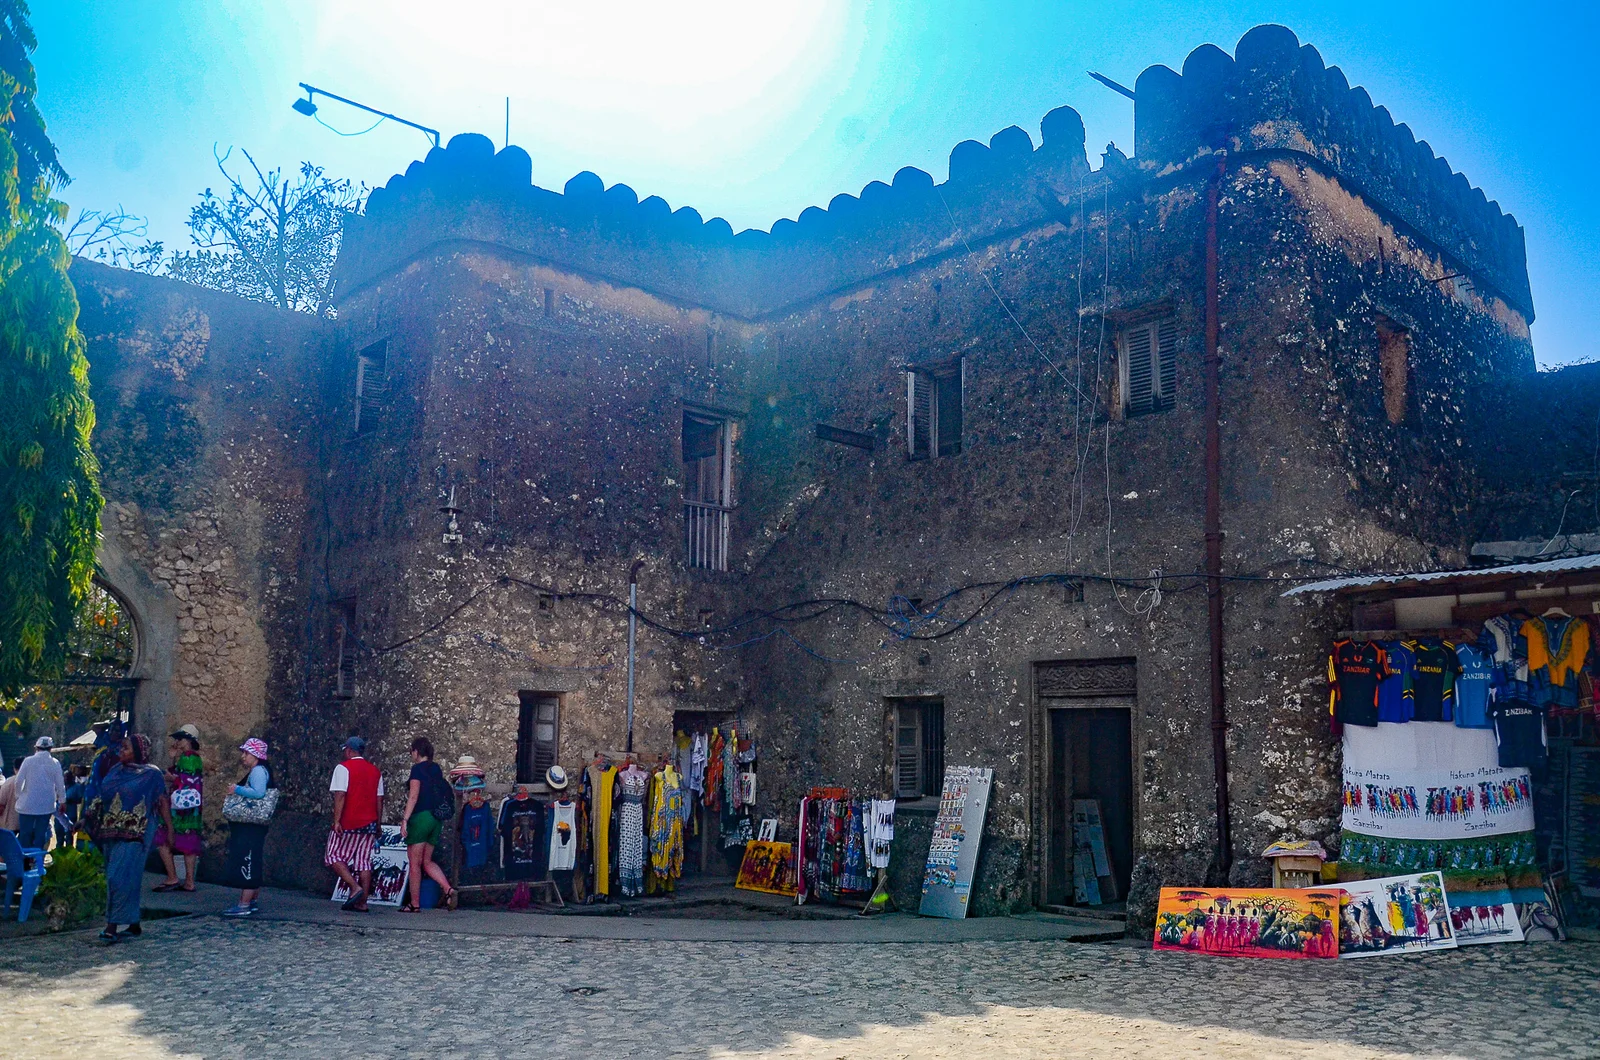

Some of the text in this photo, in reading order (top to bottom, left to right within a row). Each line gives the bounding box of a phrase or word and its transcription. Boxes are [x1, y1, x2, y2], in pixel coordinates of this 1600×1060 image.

[1343, 666, 1370, 674] ZANZIBAR
[1505, 708, 1532, 716] ZNZIBAR
[1343, 766, 1390, 780] akuna Matata
[1449, 767, 1504, 780] Hakuna Matata
[1353, 818, 1383, 830] Zanzibar
[1464, 820, 1497, 831] Zanzibar
[1477, 876, 1506, 887] Zanziba
